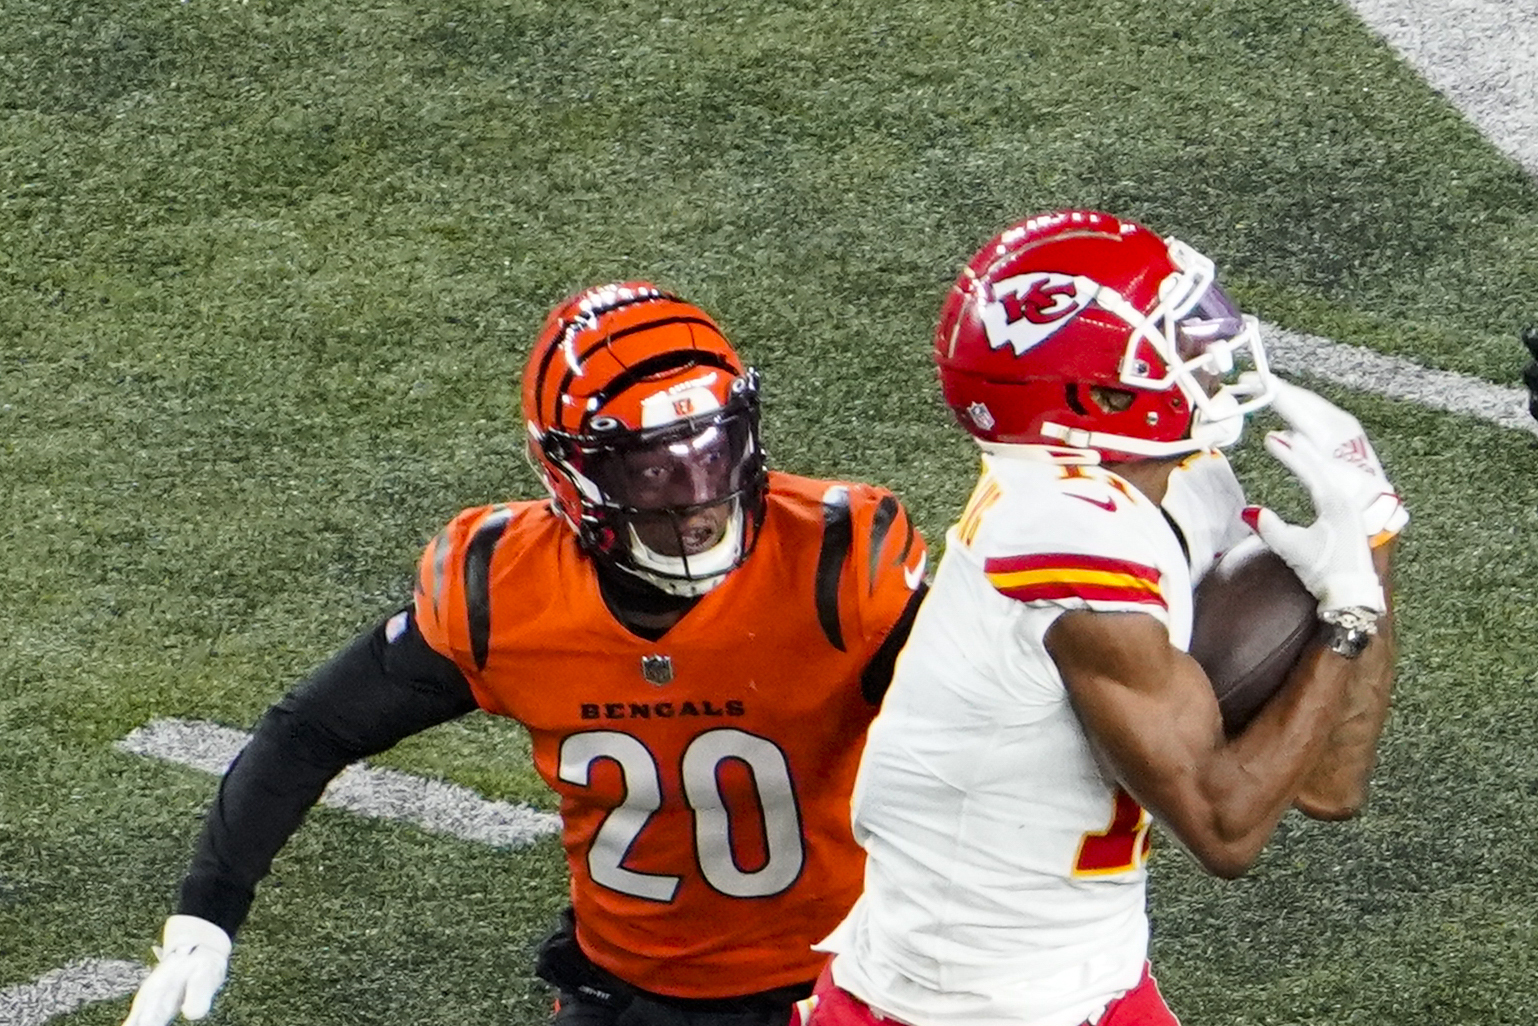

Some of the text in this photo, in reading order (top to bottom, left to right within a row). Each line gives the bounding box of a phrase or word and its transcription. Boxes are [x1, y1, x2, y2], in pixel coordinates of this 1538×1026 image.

[998, 277, 1079, 325] KC
[580, 699, 746, 720] BENGALS
[557, 727, 804, 903] 20
